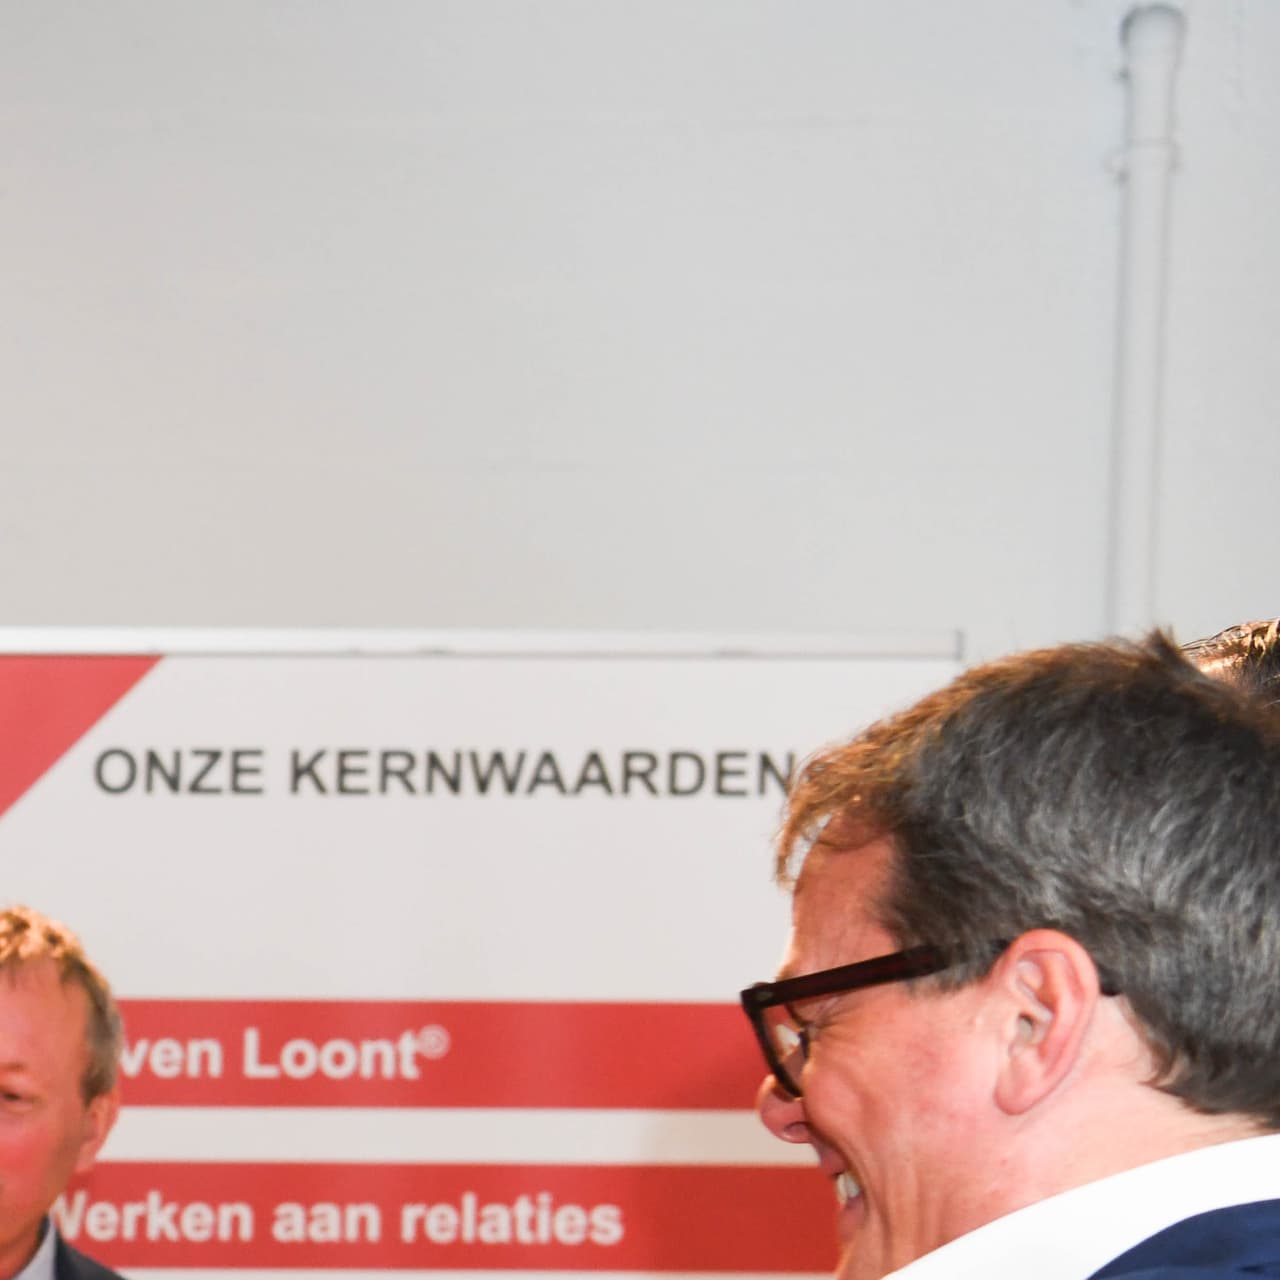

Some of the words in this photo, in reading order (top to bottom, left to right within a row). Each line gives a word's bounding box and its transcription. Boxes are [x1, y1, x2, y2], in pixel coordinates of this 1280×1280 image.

[93, 747, 265, 796] ONZE
[290, 748, 795, 798] KERNWAARDEN
[271, 1202, 382, 1244] aan
[400, 1190, 626, 1246] relaties
